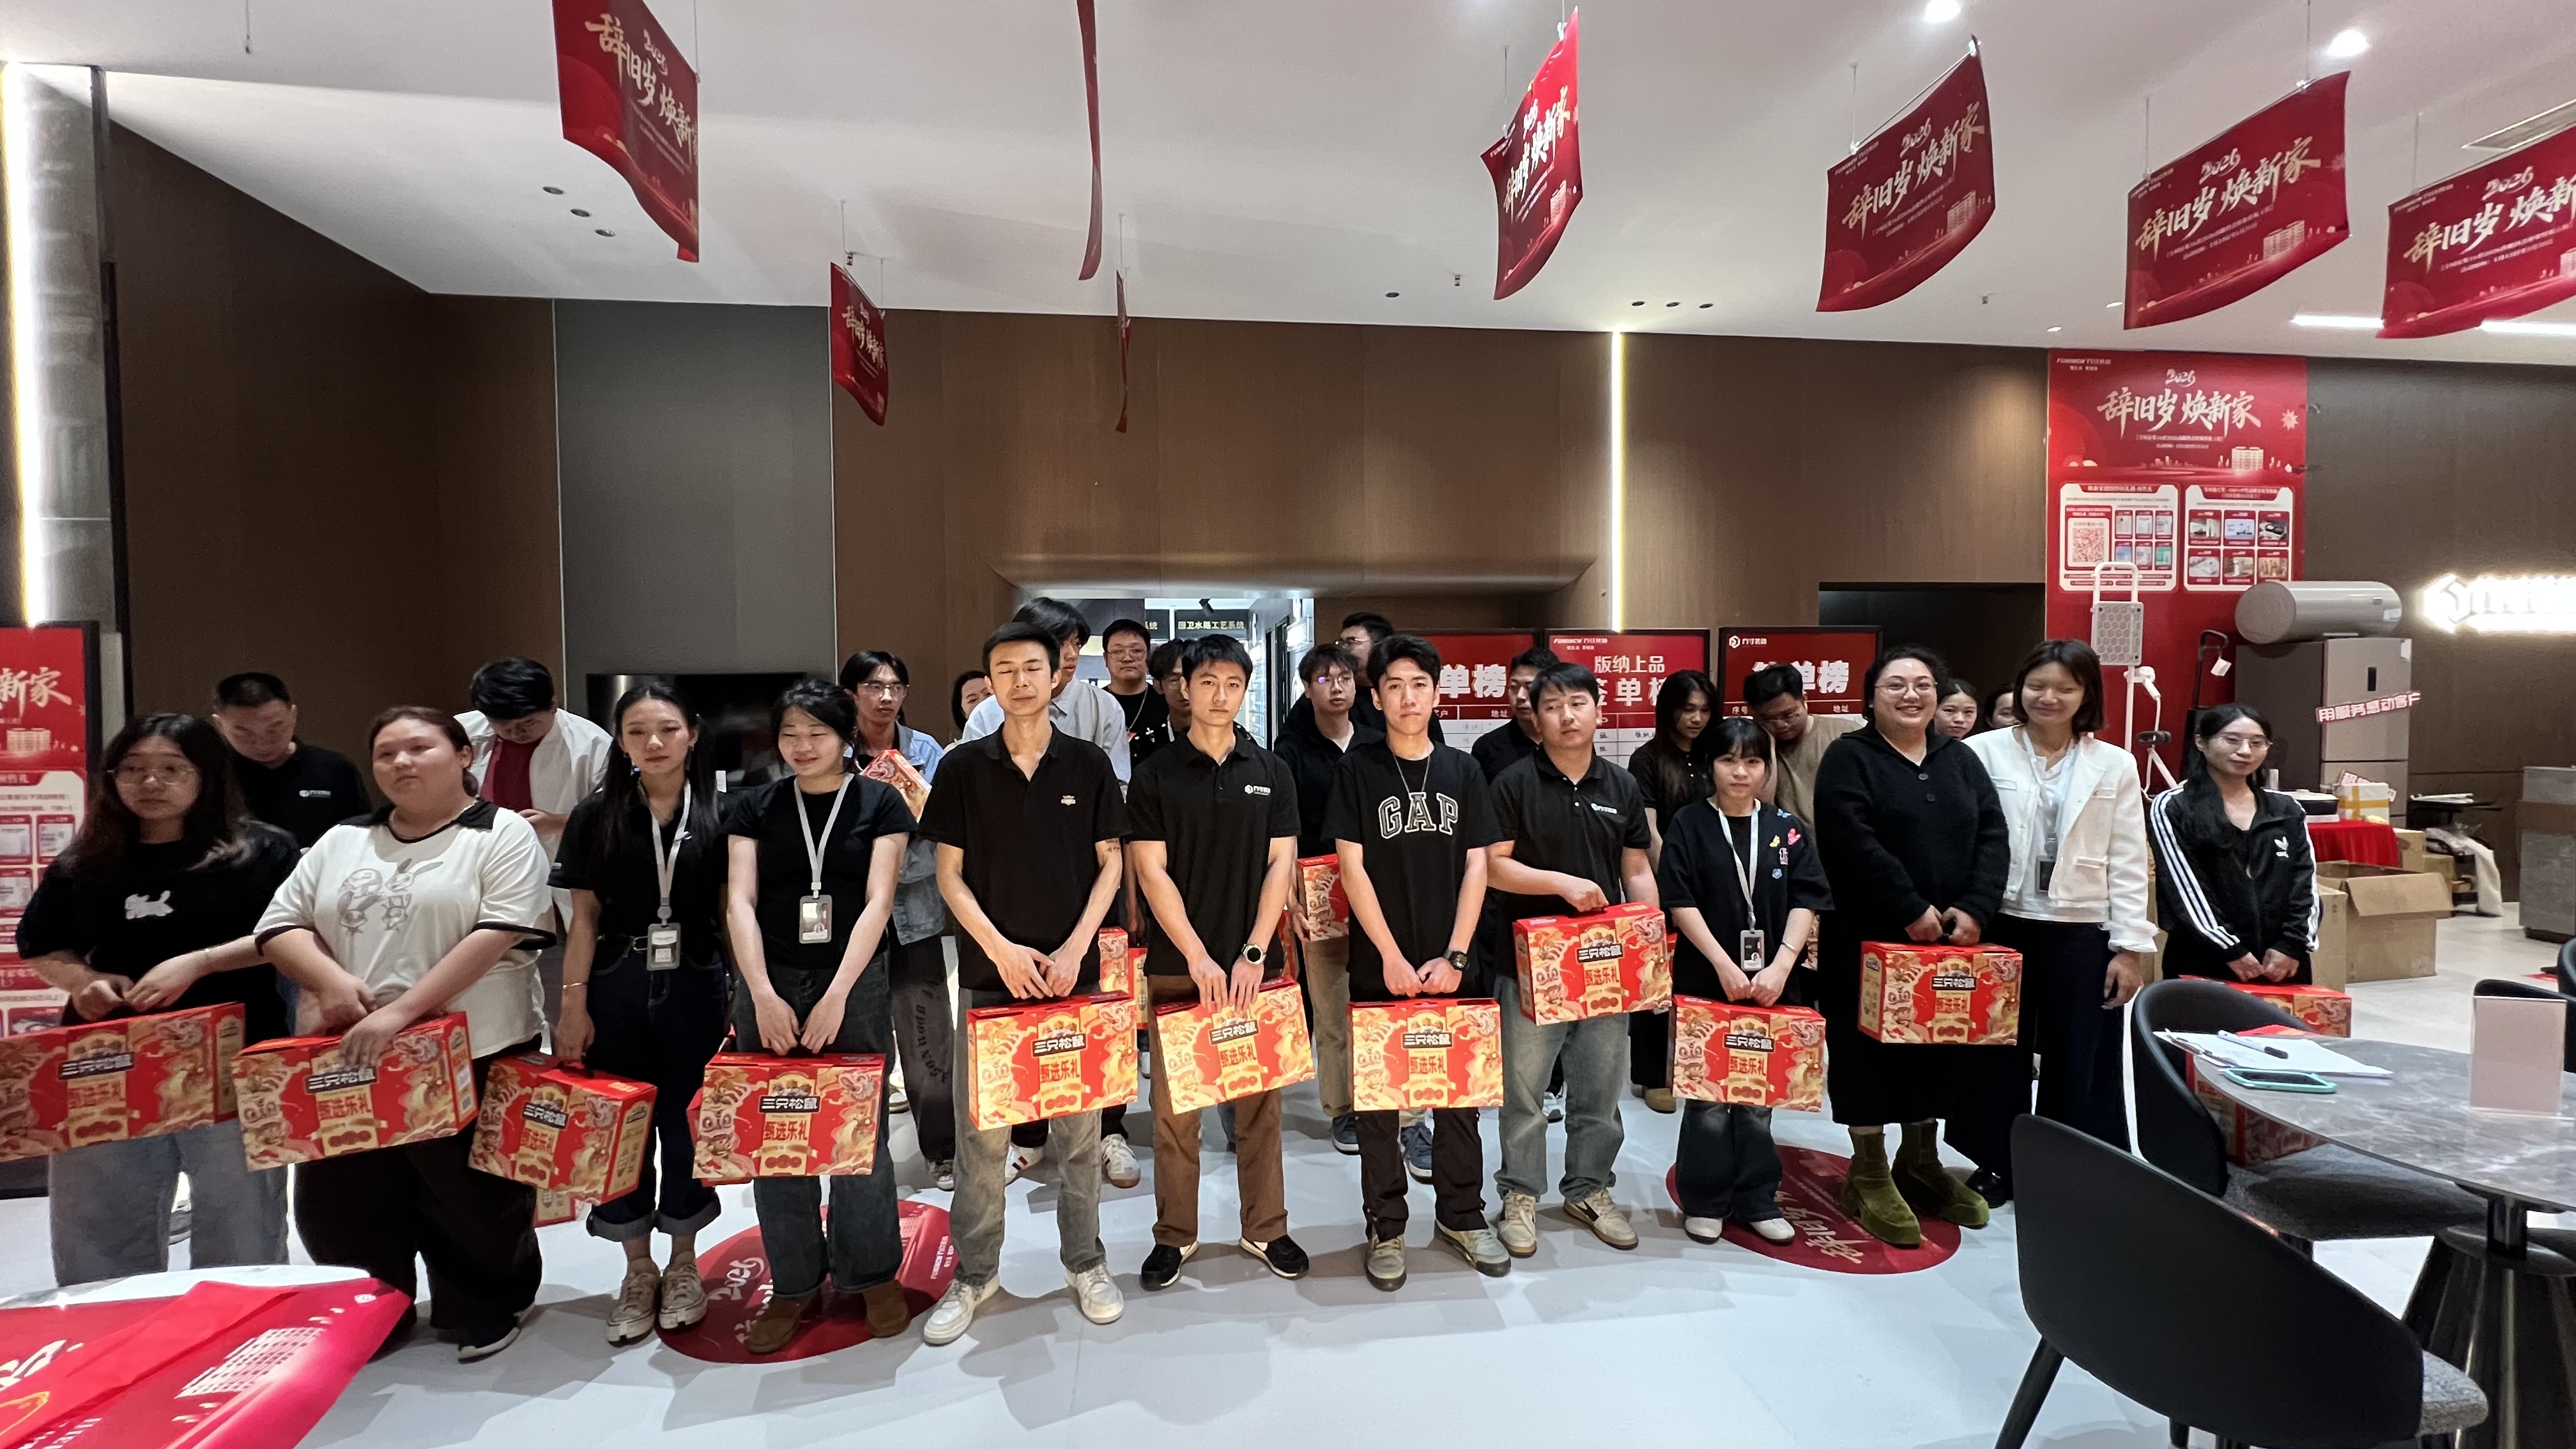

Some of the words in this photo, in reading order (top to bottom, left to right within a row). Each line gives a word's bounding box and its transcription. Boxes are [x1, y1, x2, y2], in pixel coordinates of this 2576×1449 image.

[2198, 148, 2241, 185] 2026
[2481, 165, 2534, 201] 2026
[2165, 369, 2195, 387] 2026
[1593, 656, 1665, 673] 版纳上品
[0, 667, 72, 717] 新家
[1378, 792, 1459, 839] GAP
[1578, 945, 1622, 960] 三只松鼠
[1211, 1022, 1257, 1041] 三只松鼠
[1404, 1034, 1450, 1045] 三只松鼠
[1034, 1035, 1085, 1054] 三只松鼠
[1726, 1036, 1772, 1050] 三只松鼠
[309, 1068, 376, 1090] 三只松鼠
[762, 1098, 817, 1110] 三只松鼠
